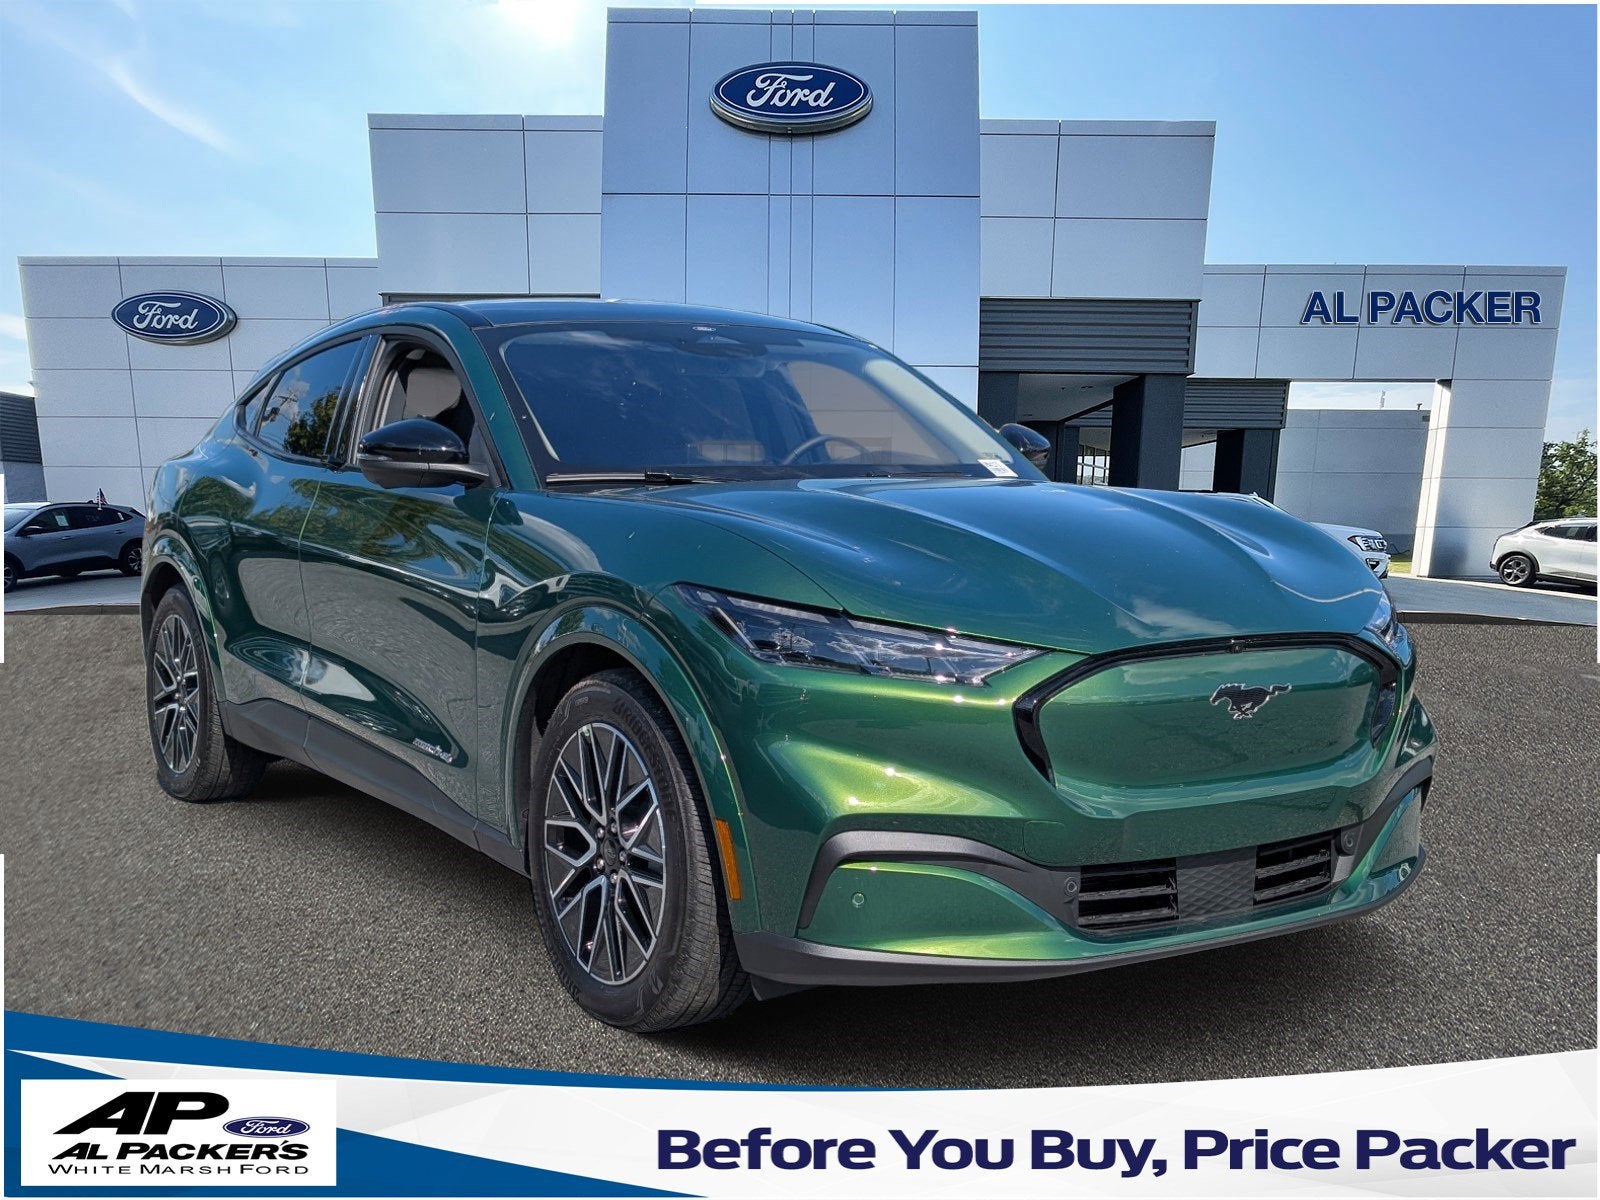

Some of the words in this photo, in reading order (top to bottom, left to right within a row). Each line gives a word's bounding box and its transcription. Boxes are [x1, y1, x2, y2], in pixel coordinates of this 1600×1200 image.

[746, 73, 836, 107] Ford
[133, 301, 199, 329] Ford
[1302, 290, 1359, 324] AL
[1369, 290, 1542, 324] PACKER
